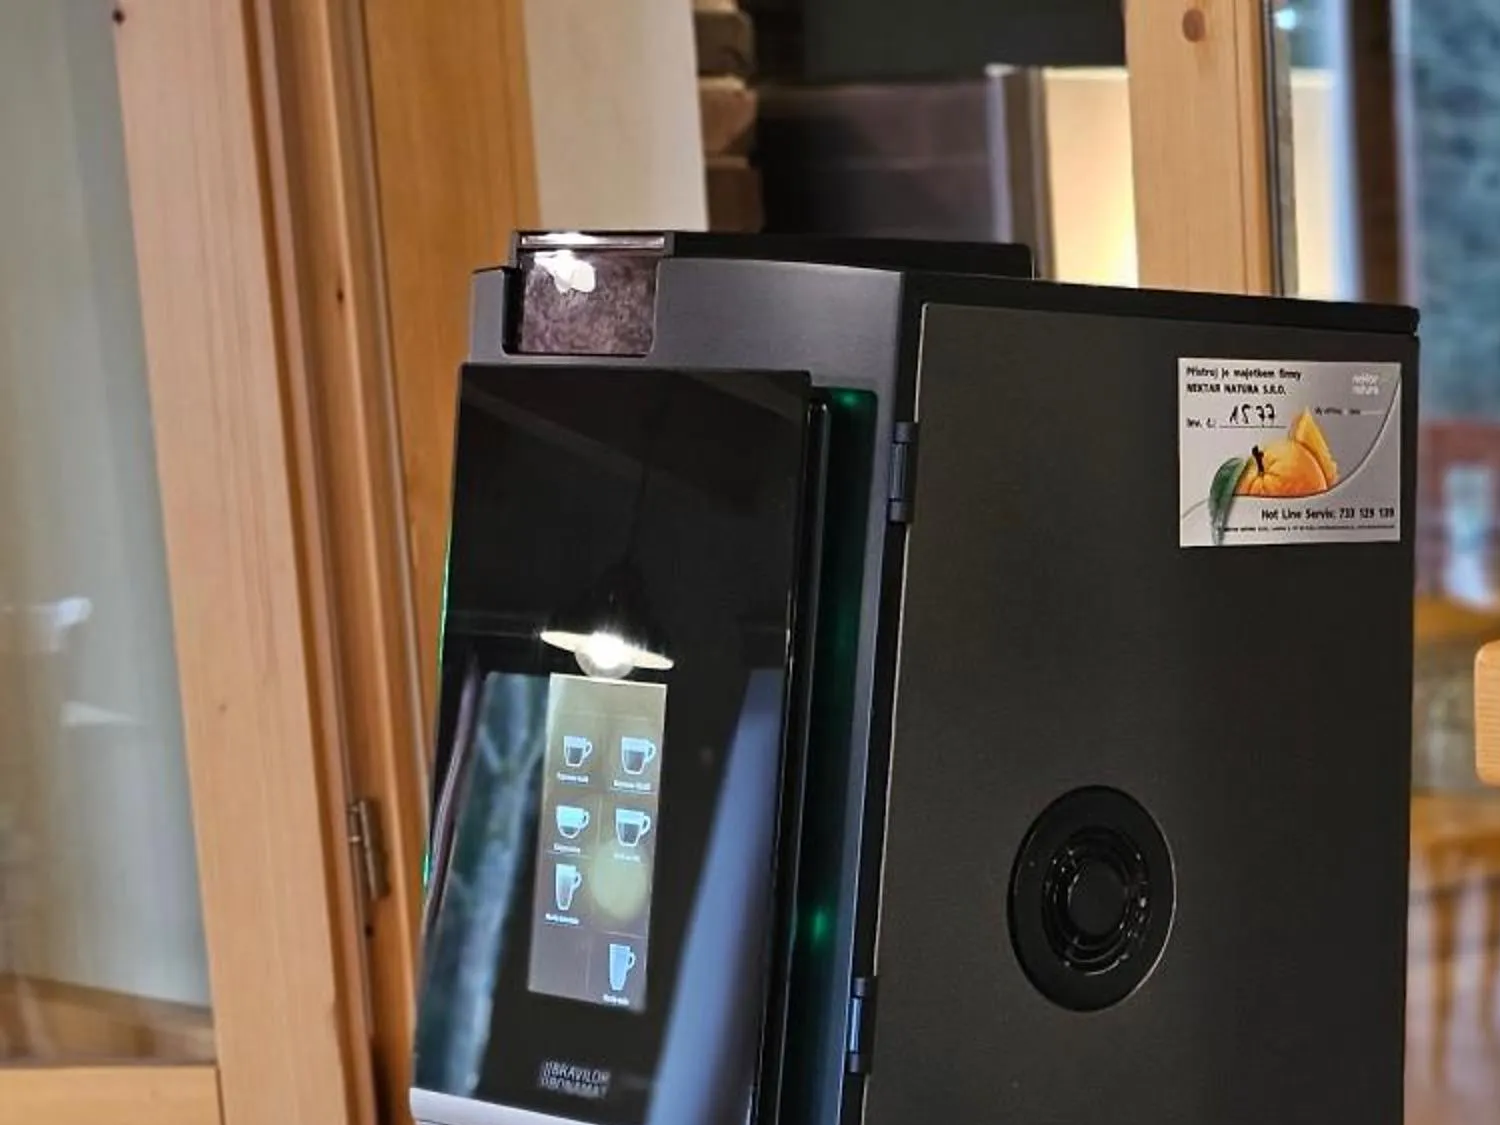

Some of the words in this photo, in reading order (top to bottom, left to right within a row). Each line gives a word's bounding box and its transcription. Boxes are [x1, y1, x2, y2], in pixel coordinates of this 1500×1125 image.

[1224, 384, 1259, 394] NATURA
[1261, 509, 1278, 520] Hot
[1282, 509, 1301, 519] Line
